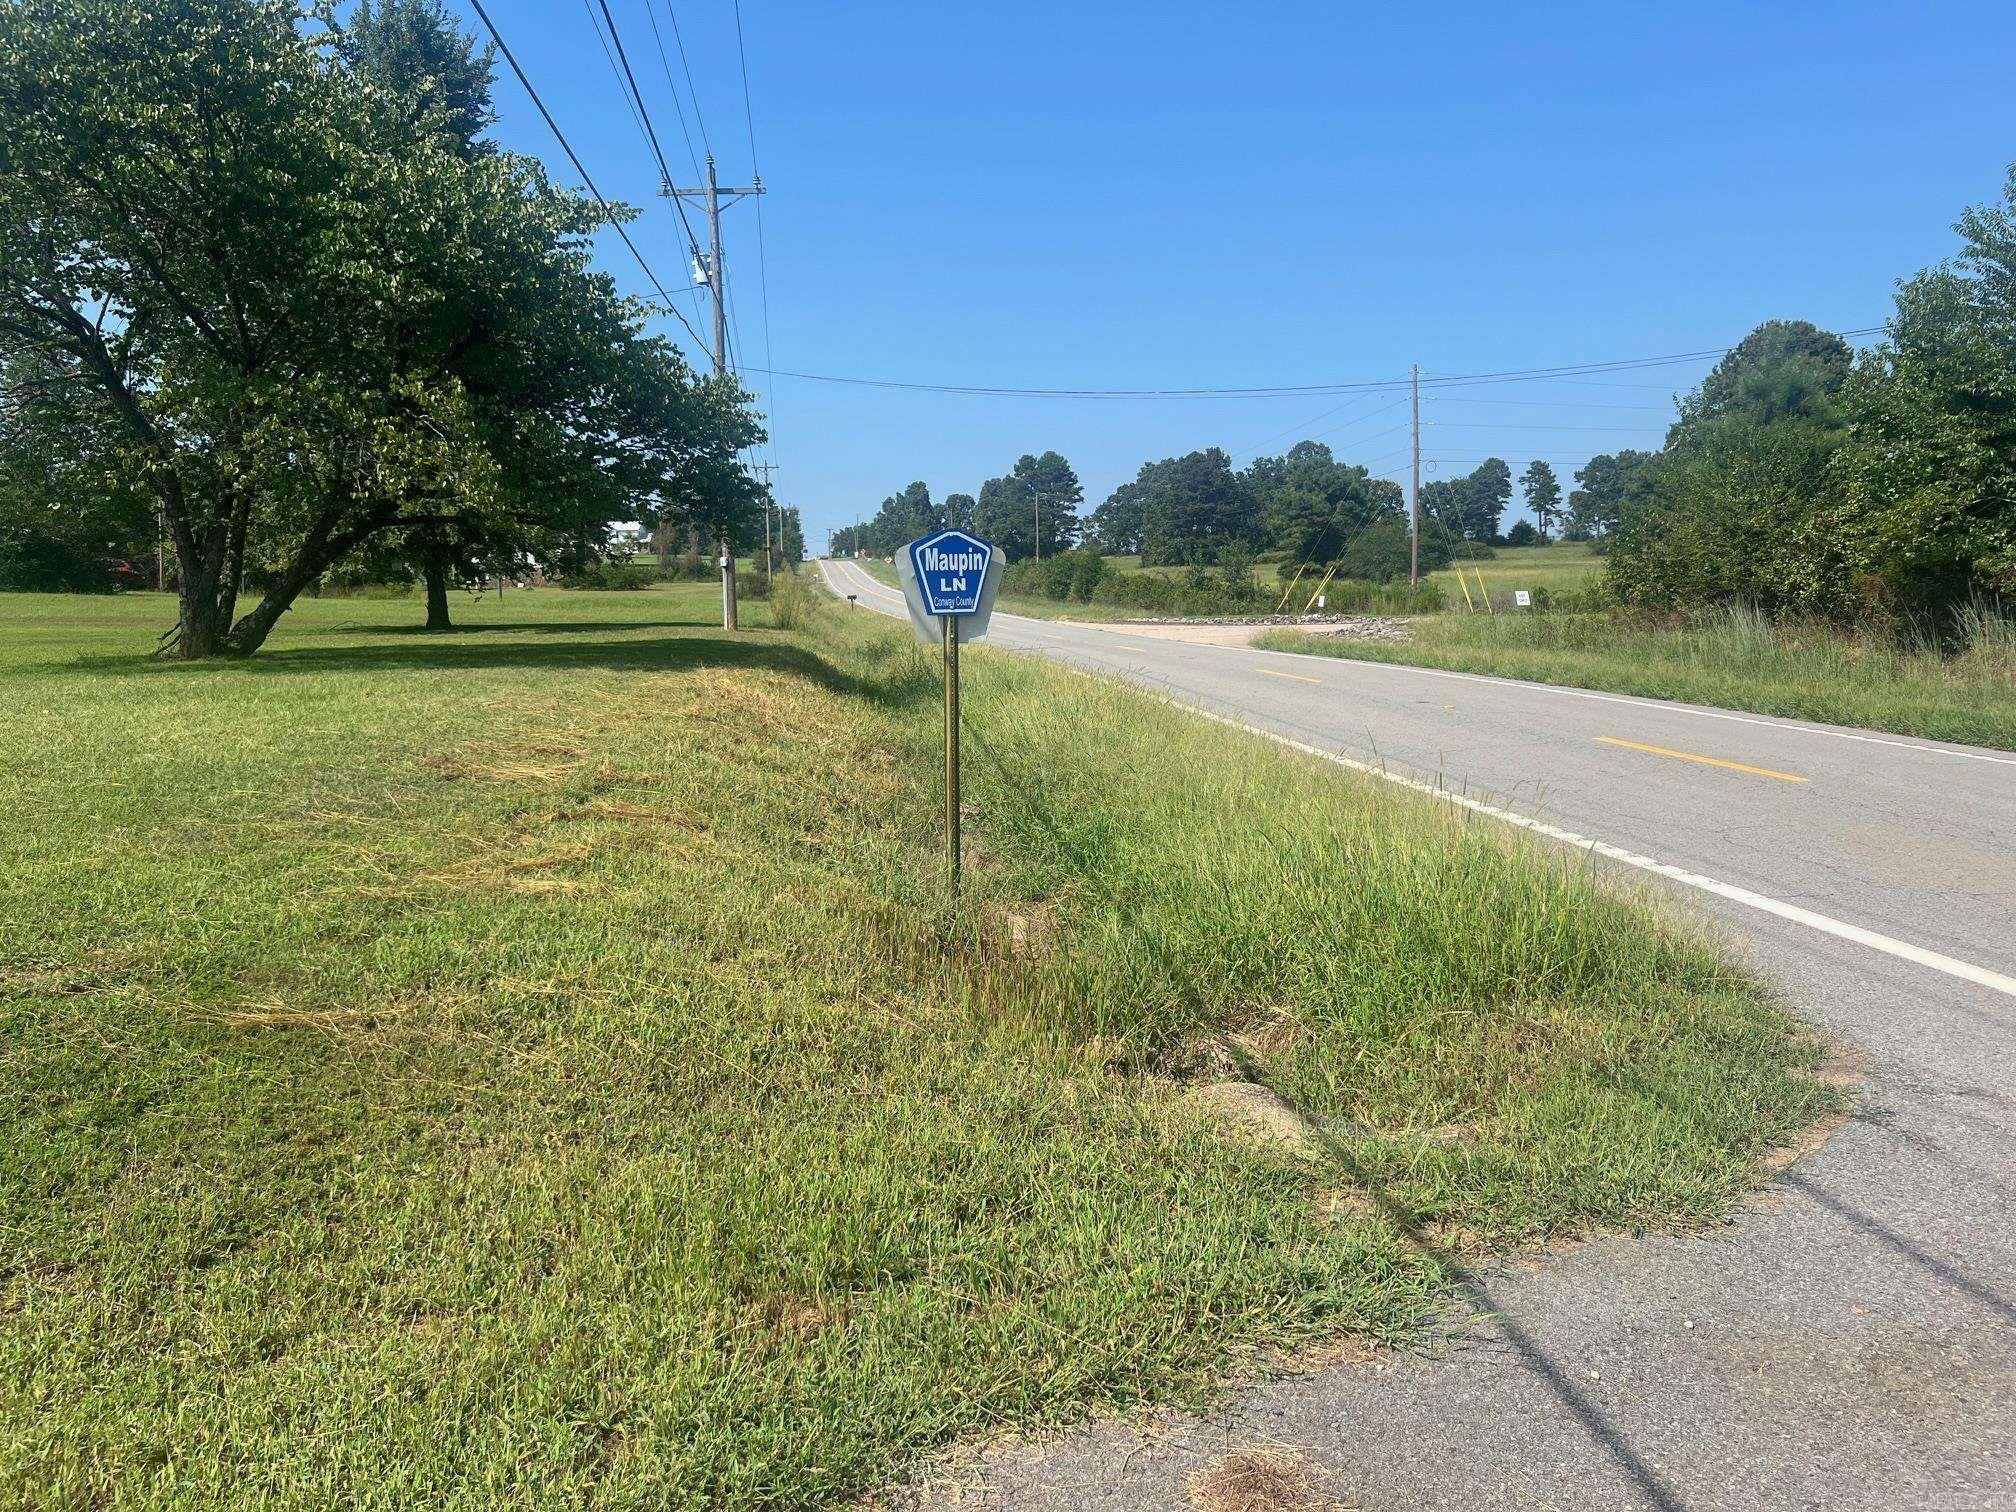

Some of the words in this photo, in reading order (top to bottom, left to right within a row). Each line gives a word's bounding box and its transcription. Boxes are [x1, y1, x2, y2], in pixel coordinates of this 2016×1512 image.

[925, 547, 983, 576] Maupin
[940, 578, 966, 591] LN
[934, 596, 954, 607] Conway
[956, 596, 975, 607] County
